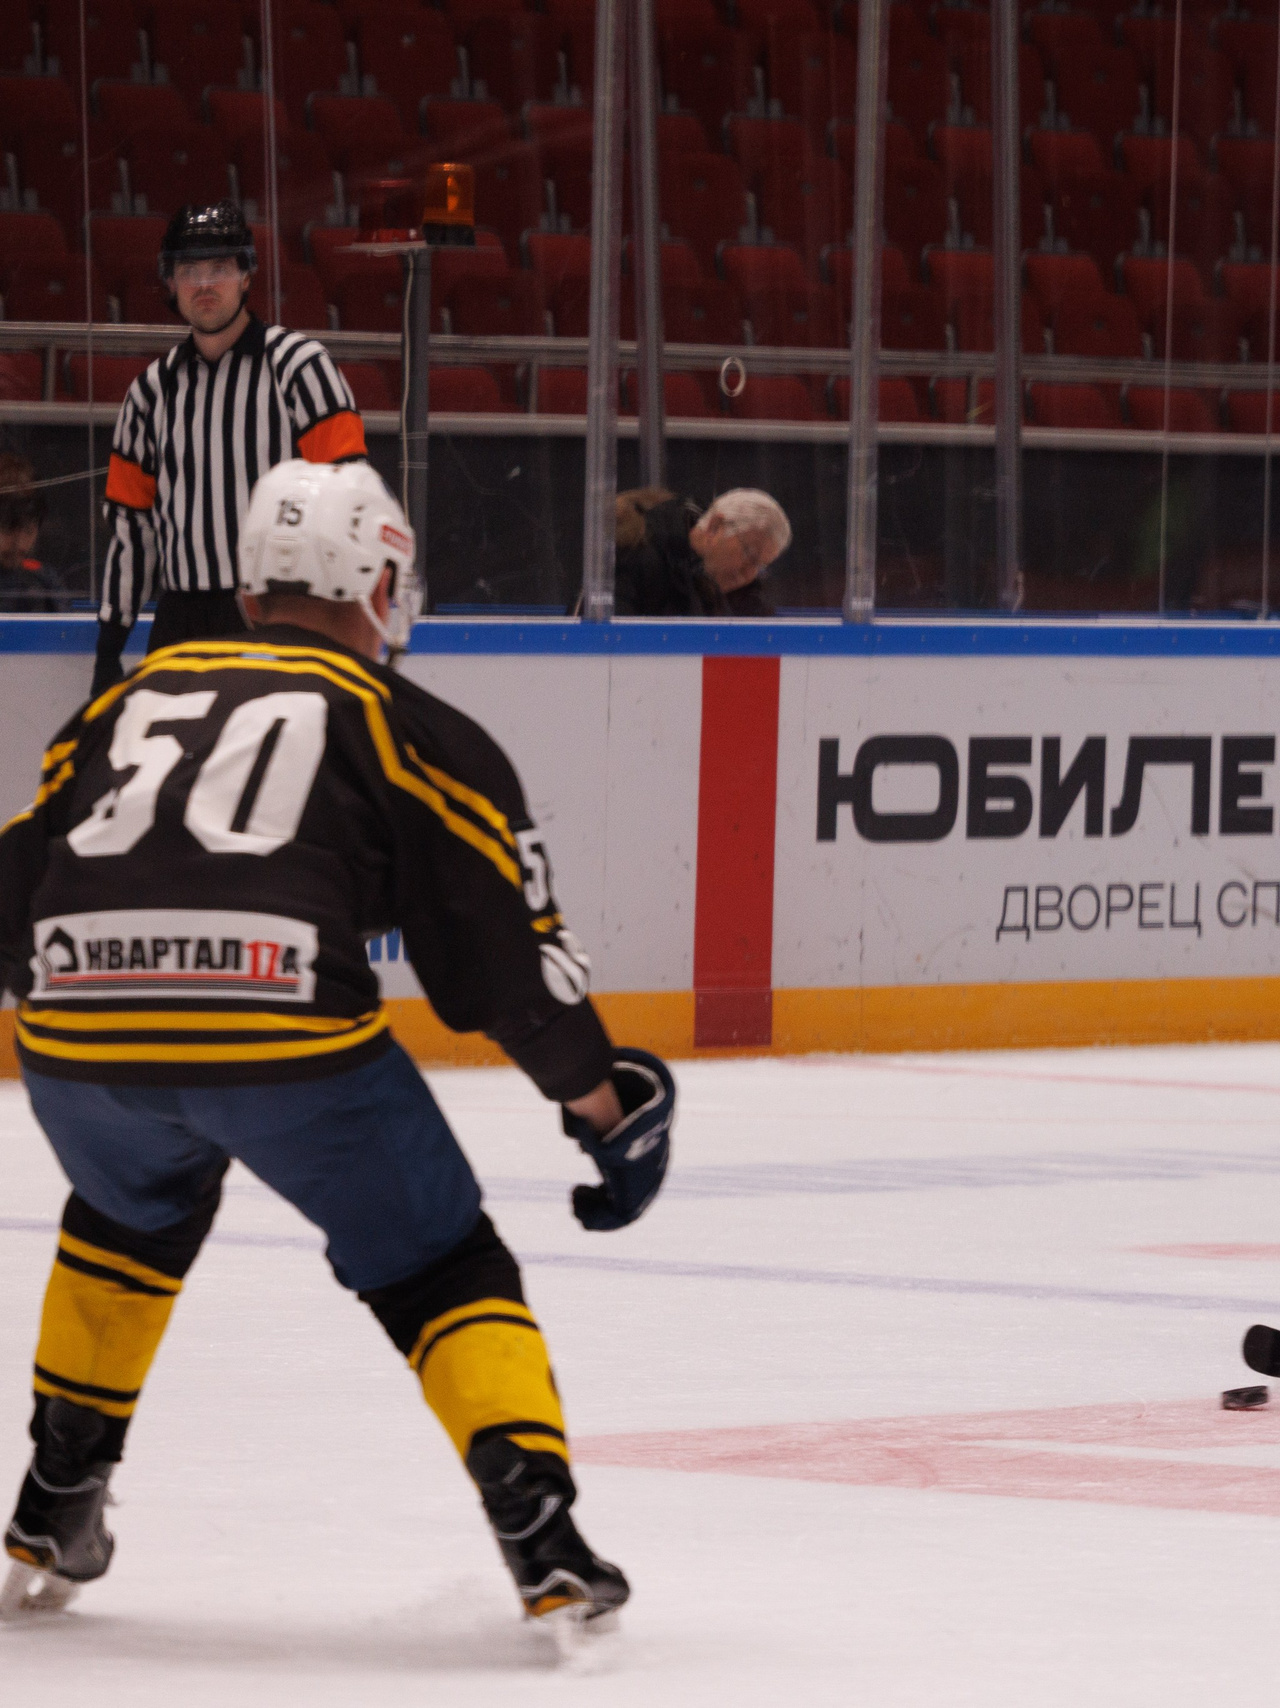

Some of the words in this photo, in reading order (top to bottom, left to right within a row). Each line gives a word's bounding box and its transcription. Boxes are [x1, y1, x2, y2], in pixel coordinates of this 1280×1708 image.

[66, 688, 329, 858] 50
[514, 827, 553, 913] 5
[996, 880, 1202, 942] ДВОРЕЦ
